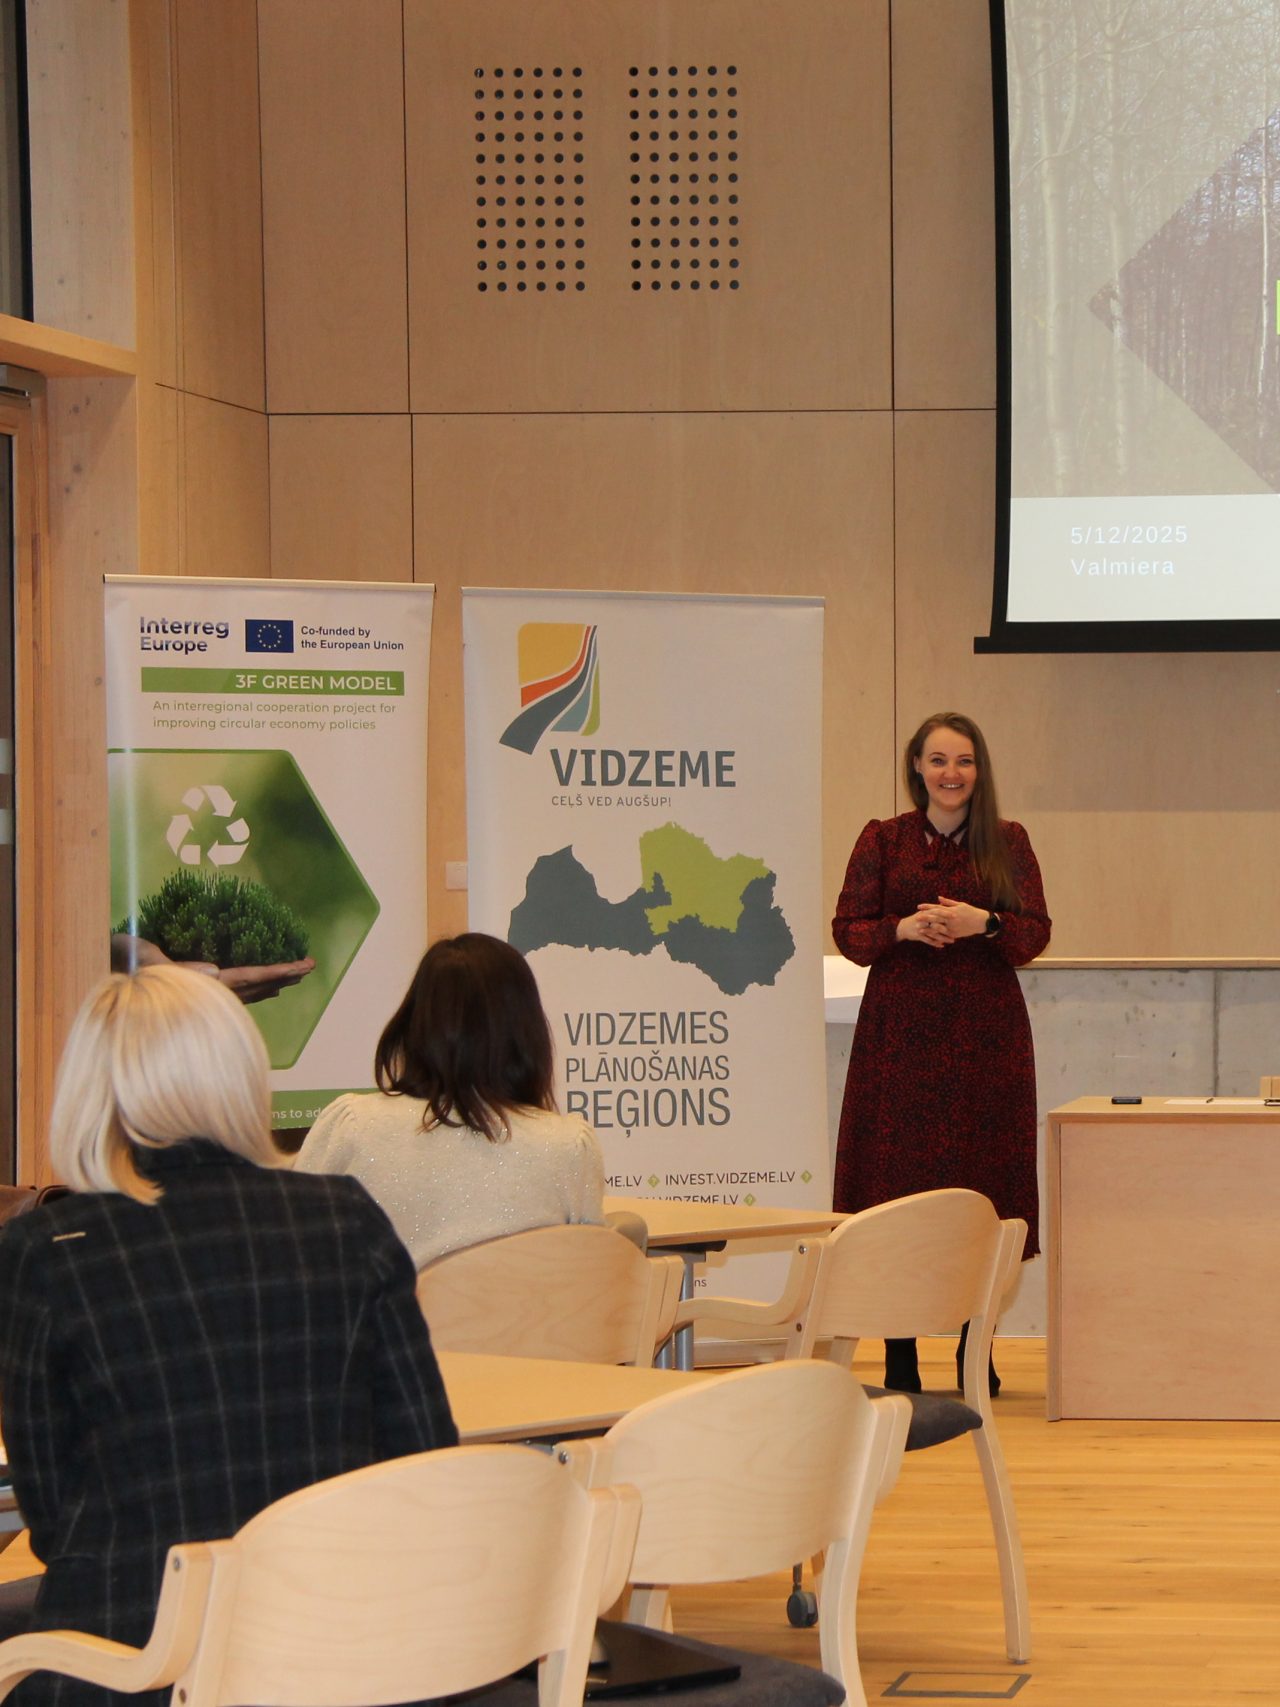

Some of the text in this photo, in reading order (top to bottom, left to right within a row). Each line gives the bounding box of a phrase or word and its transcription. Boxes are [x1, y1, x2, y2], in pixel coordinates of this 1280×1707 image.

[1070, 525, 1188, 545] 5/12/2025
[1070, 556, 1175, 576] Valmiera
[140, 616, 230, 638] Interreg
[301, 625, 370, 638] Co-funded by
[140, 636, 209, 655] Europe
[301, 640, 404, 651] the European Union
[235, 674, 396, 691] 3F GREEN MODEL
[153, 700, 396, 717] An interregional cooperation project for
[153, 718, 376, 733] improving circular economy policies
[550, 748, 736, 788] VIDZEME
[551, 794, 672, 808] CEĻŠ VED AUGŠUP!
[563, 1010, 730, 1047] VIDZEMES
[565, 1050, 730, 1083] PLĀNOŠANAS
[272, 1111, 287, 1119] ns
[290, 1110, 303, 1118] to
[566, 1087, 731, 1138] REĢIONS
[604, 1171, 796, 1187] ME.LV INVEST.VIDZEME.LV
[694, 1279, 707, 1288] ns
